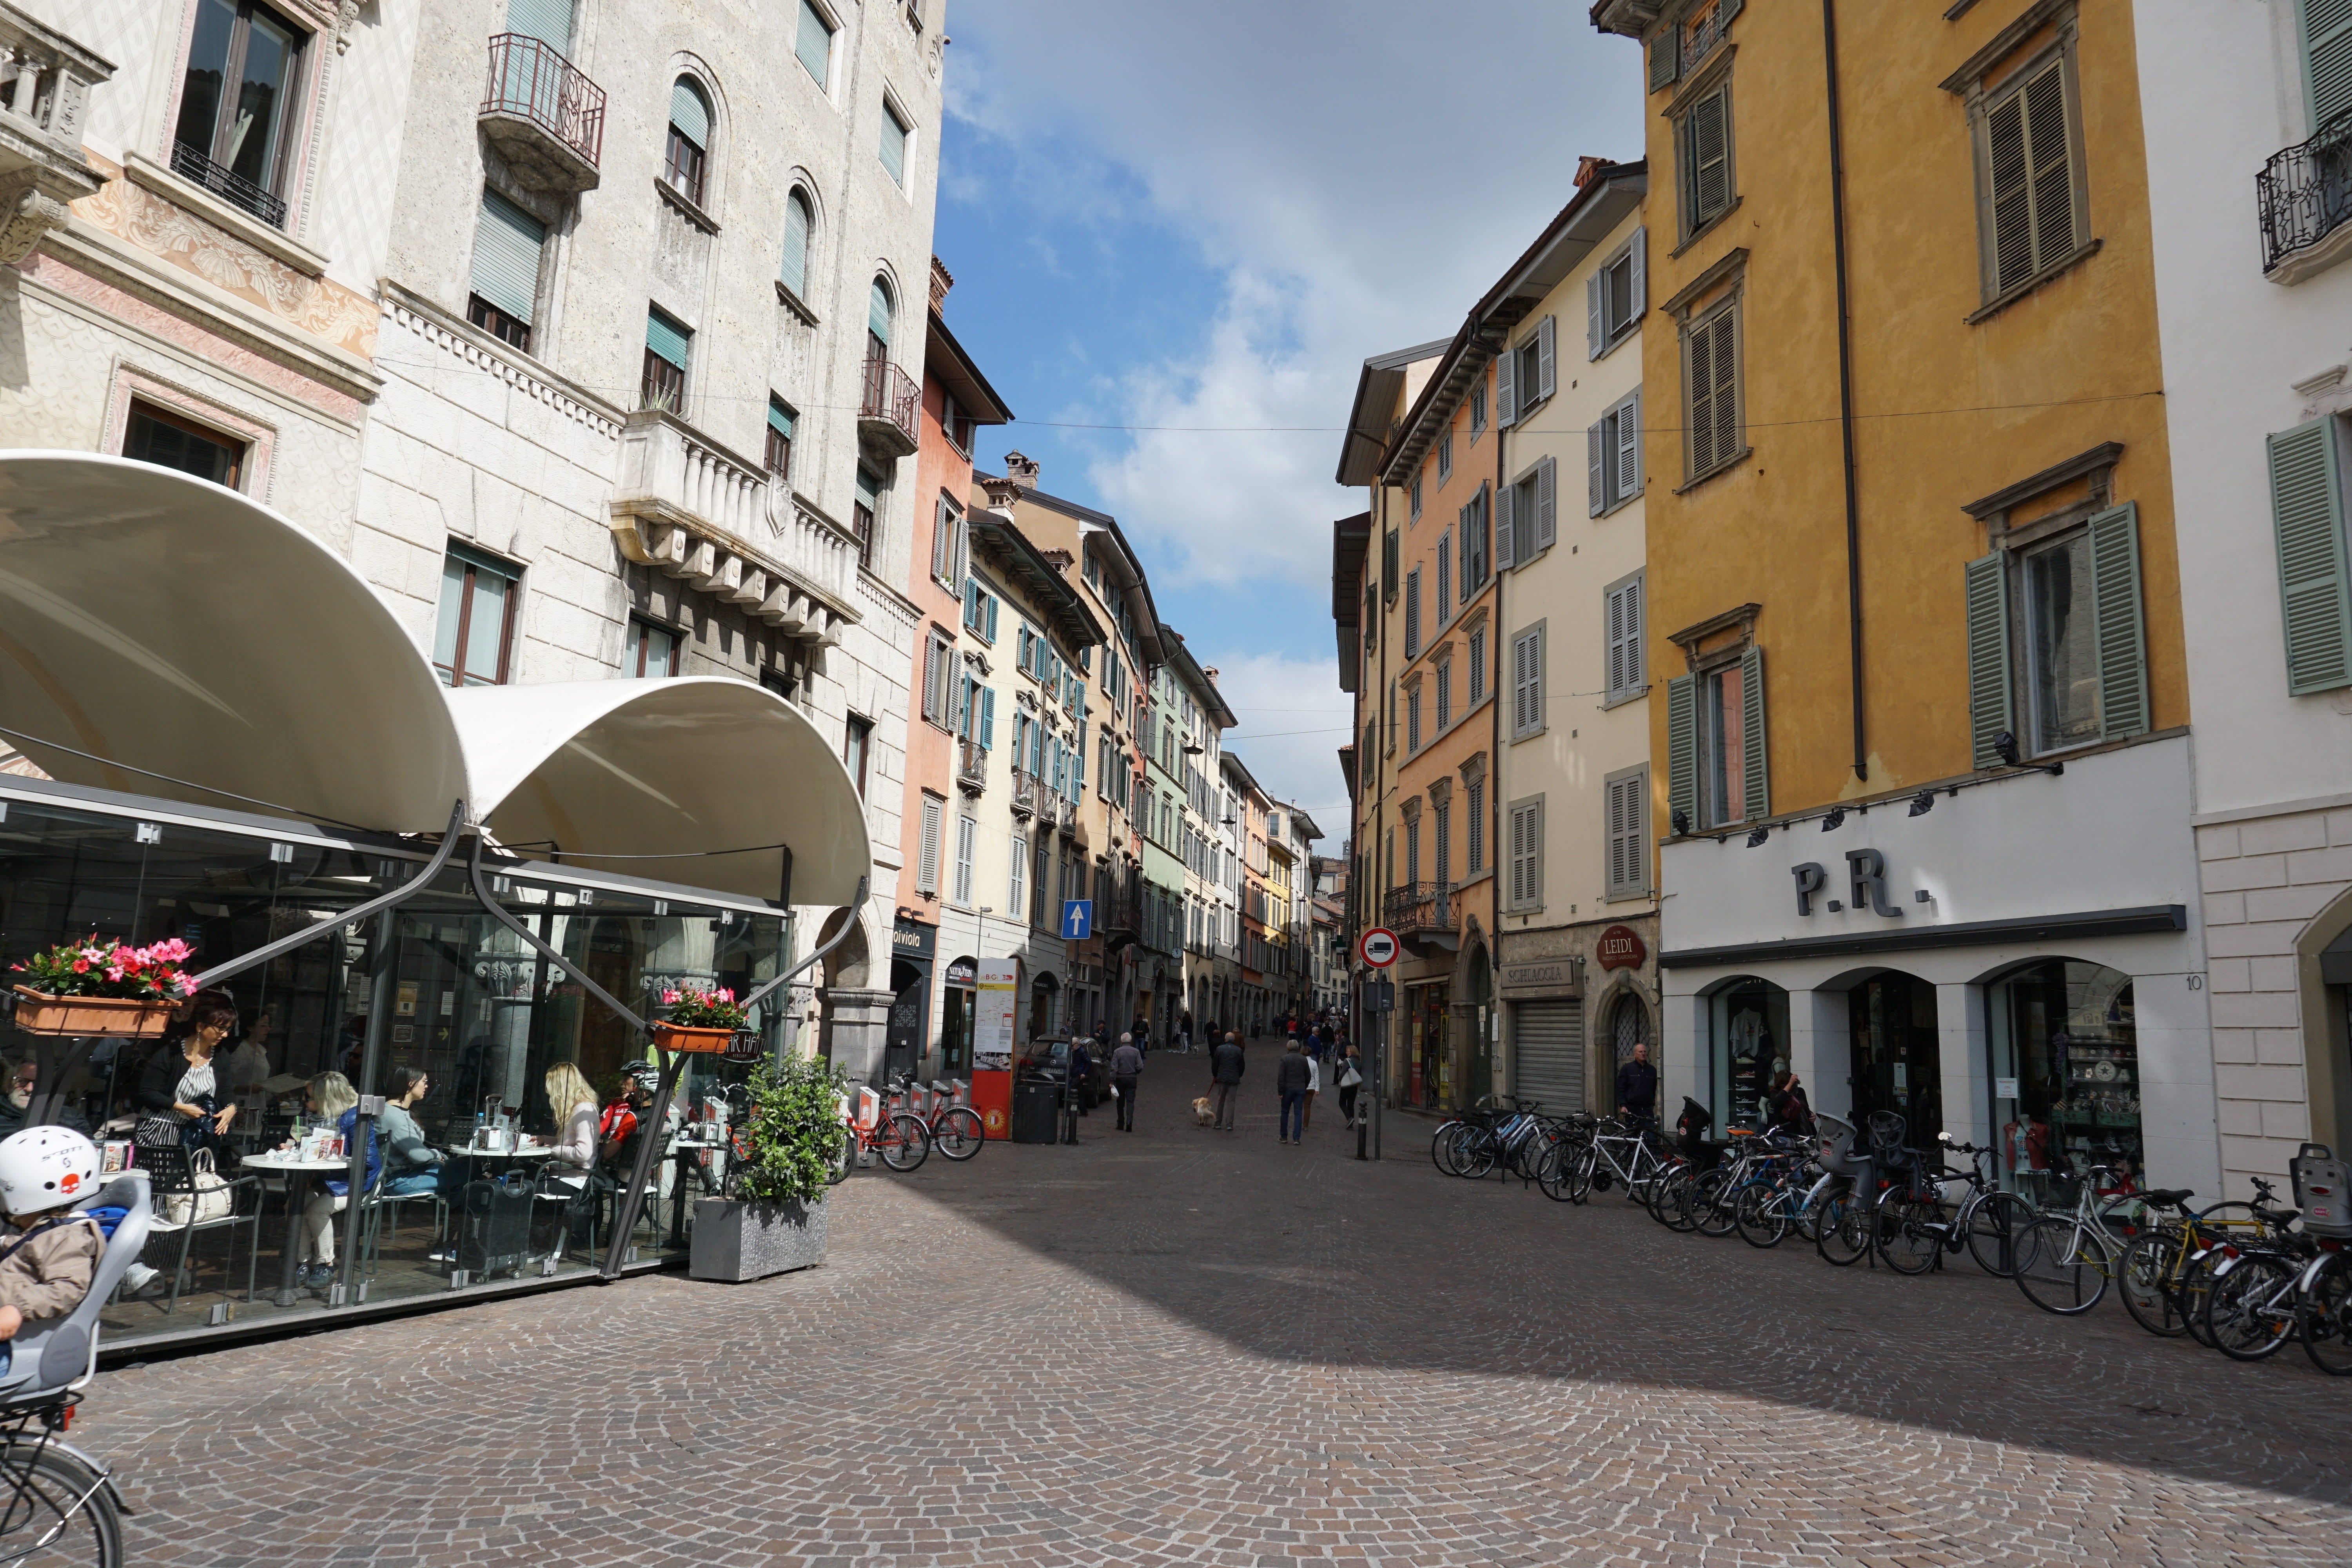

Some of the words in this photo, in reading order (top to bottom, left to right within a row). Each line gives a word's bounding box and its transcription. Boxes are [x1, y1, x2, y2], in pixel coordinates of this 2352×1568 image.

[1791, 848, 1929, 917] P.R.
[894, 930, 920, 947] oiviola
[1605, 938, 1633, 954] LEIDI
[1508, 967, 1563, 983] SCHIACCIA
[2186, 976, 2201, 991] 10
[726, 1035, 740, 1053] AR
